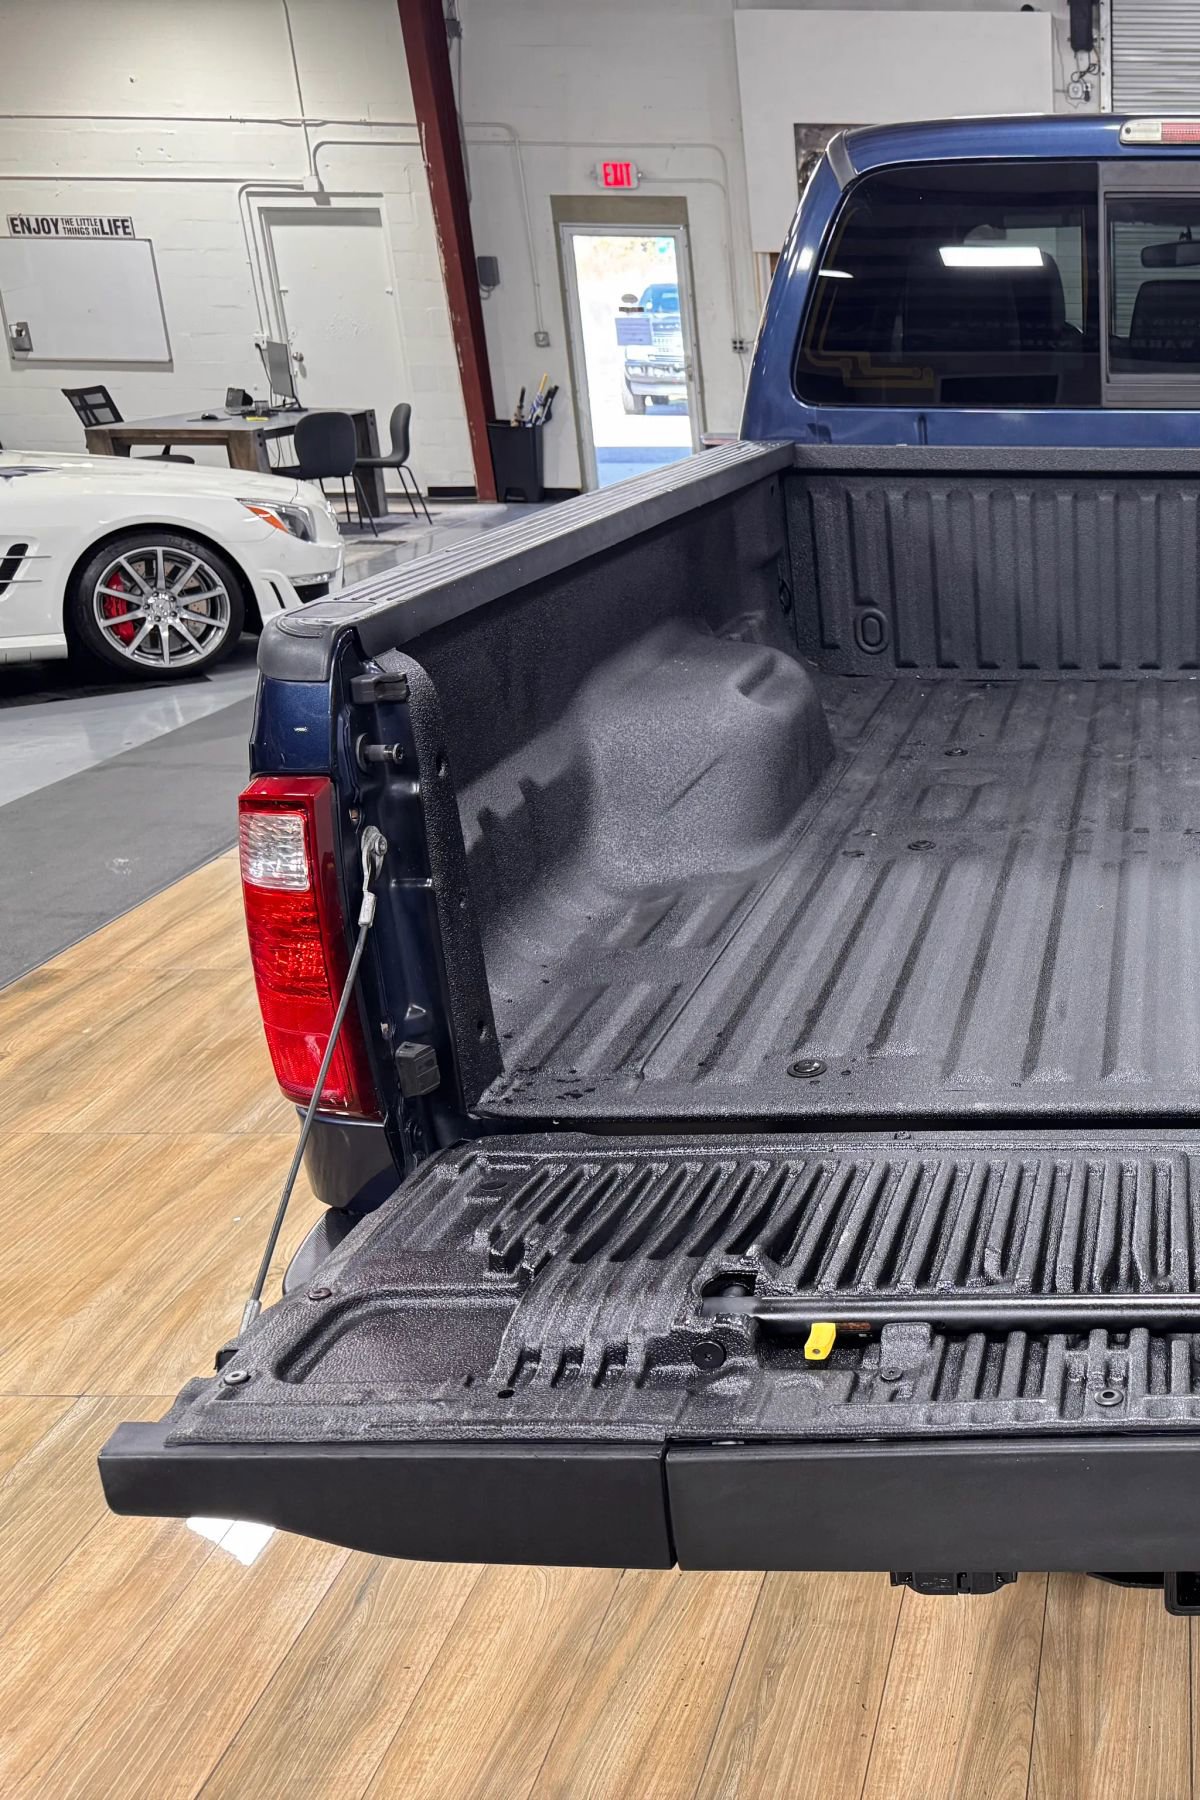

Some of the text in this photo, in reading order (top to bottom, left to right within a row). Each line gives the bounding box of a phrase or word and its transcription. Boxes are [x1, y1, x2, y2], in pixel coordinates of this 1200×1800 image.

[603, 162, 632, 187] EXIT
[10, 217, 59, 235] ENJOY
[61, 218, 98, 227] THE LITTLE
[100, 219, 131, 235] LIFE
[63, 227, 100, 235] THINGS IN
